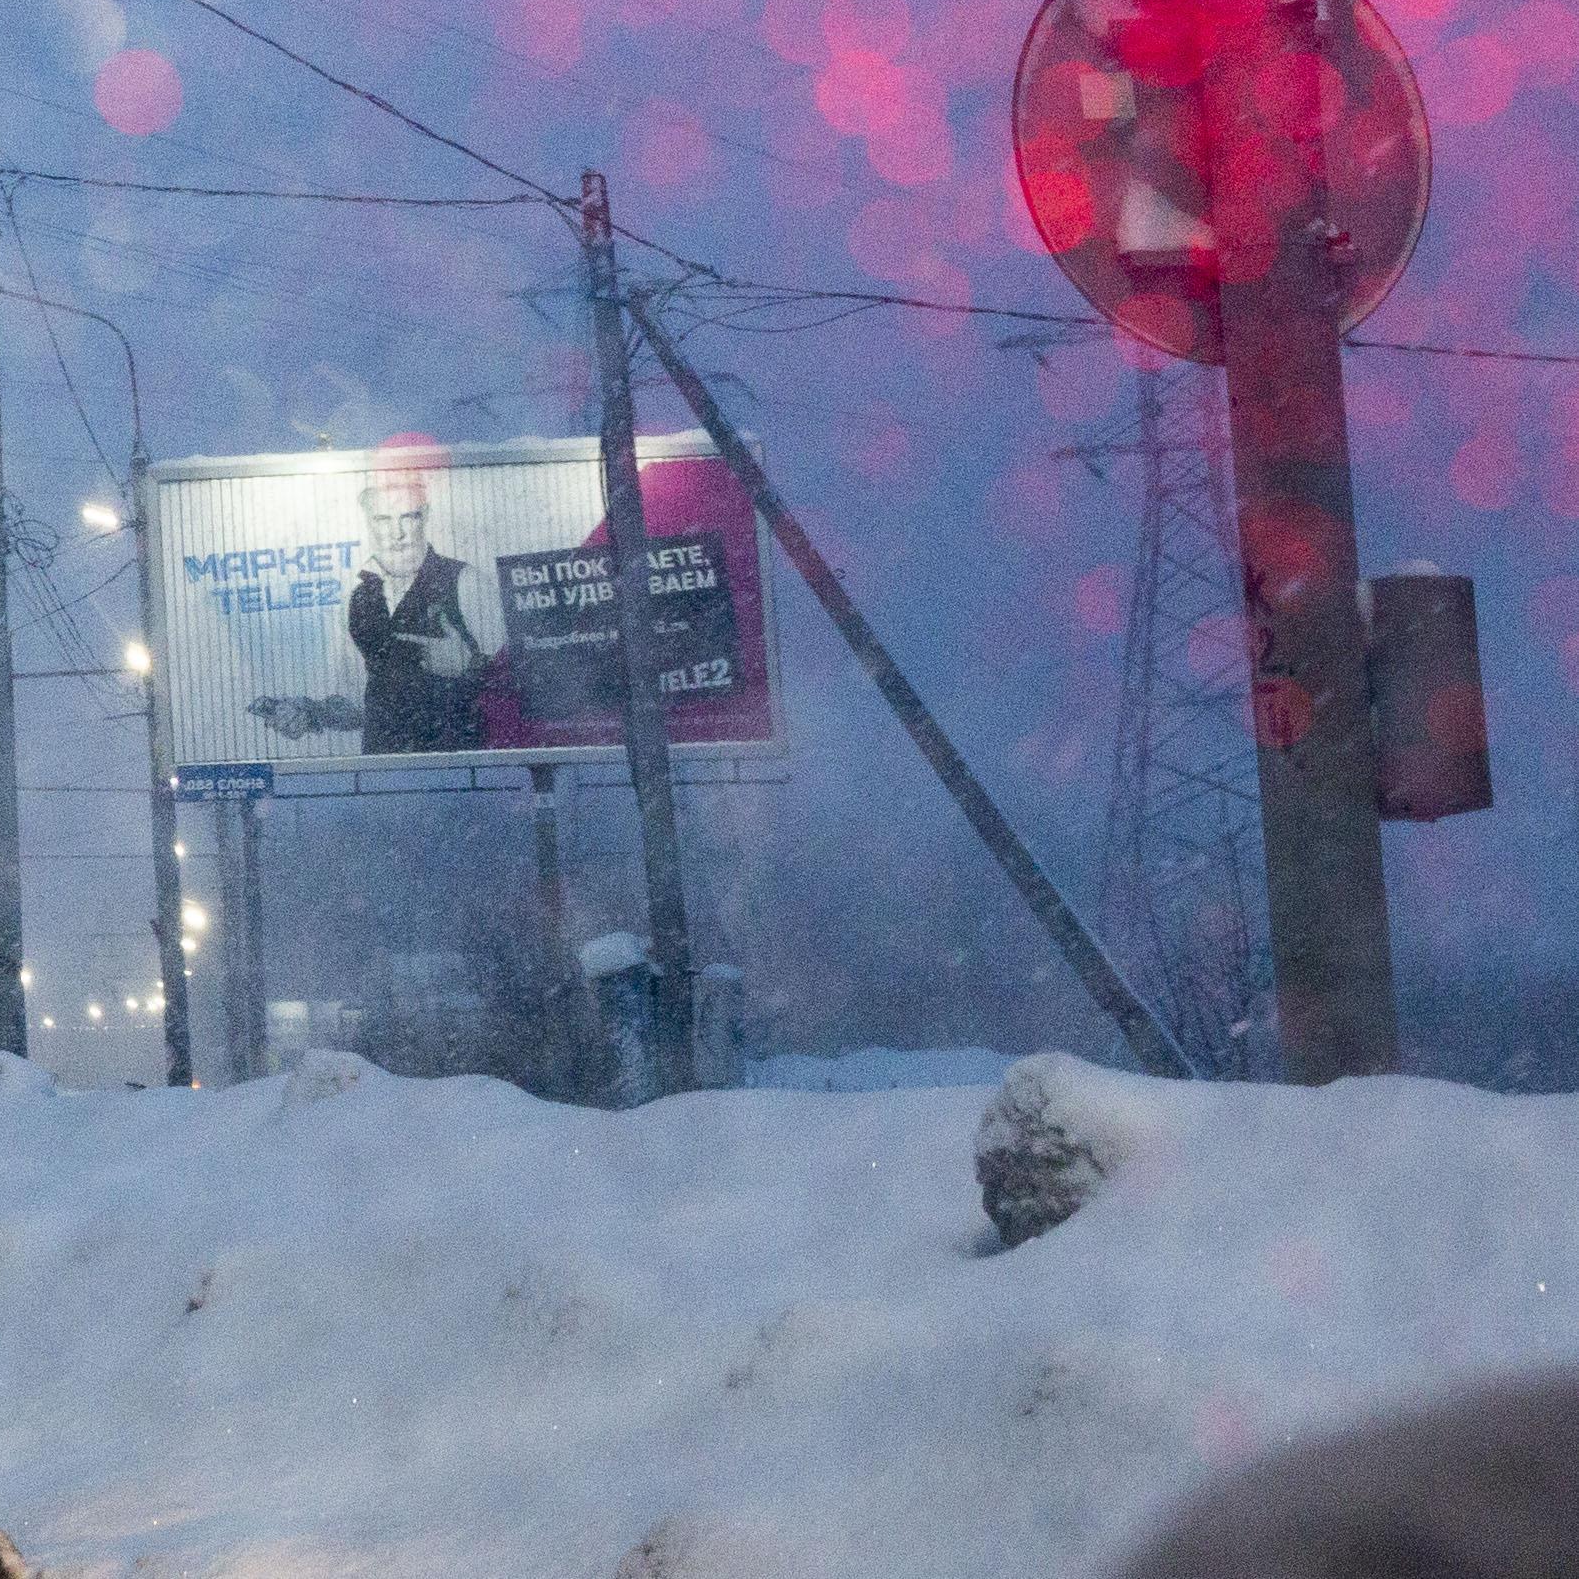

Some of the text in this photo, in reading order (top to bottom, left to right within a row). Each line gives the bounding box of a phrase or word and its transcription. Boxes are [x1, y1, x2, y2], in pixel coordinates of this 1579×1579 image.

[184, 540, 361, 583] МАРКЕТ
[511, 564, 550, 588] ВЫ
[211, 578, 342, 615] TELE2
[516, 588, 557, 612] МЫ
